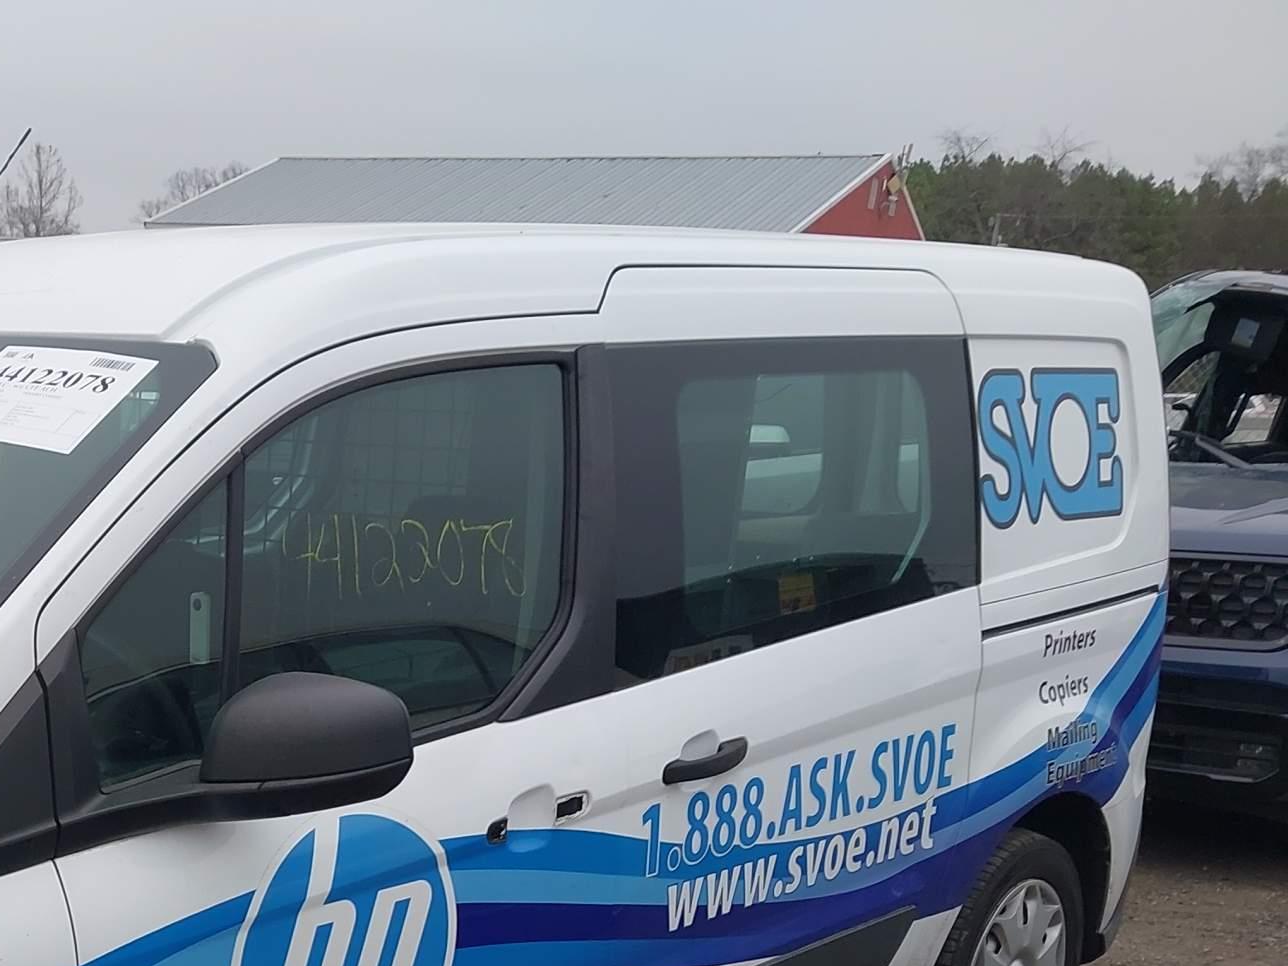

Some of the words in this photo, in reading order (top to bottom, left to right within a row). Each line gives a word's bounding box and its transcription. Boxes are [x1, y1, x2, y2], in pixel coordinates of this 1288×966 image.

[979, 367, 1124, 530] SVOE
[282, 513, 527, 599] 44122078
[1043, 629, 1096, 657] Printers
[1039, 675, 1089, 705] Copiers
[1047, 719, 1098, 754] Mailing
[1047, 742, 1117, 788] Equipment
[642, 723, 957, 877] 1.888.ASK.SVOE
[667, 798, 937, 932] www.svoe.net
